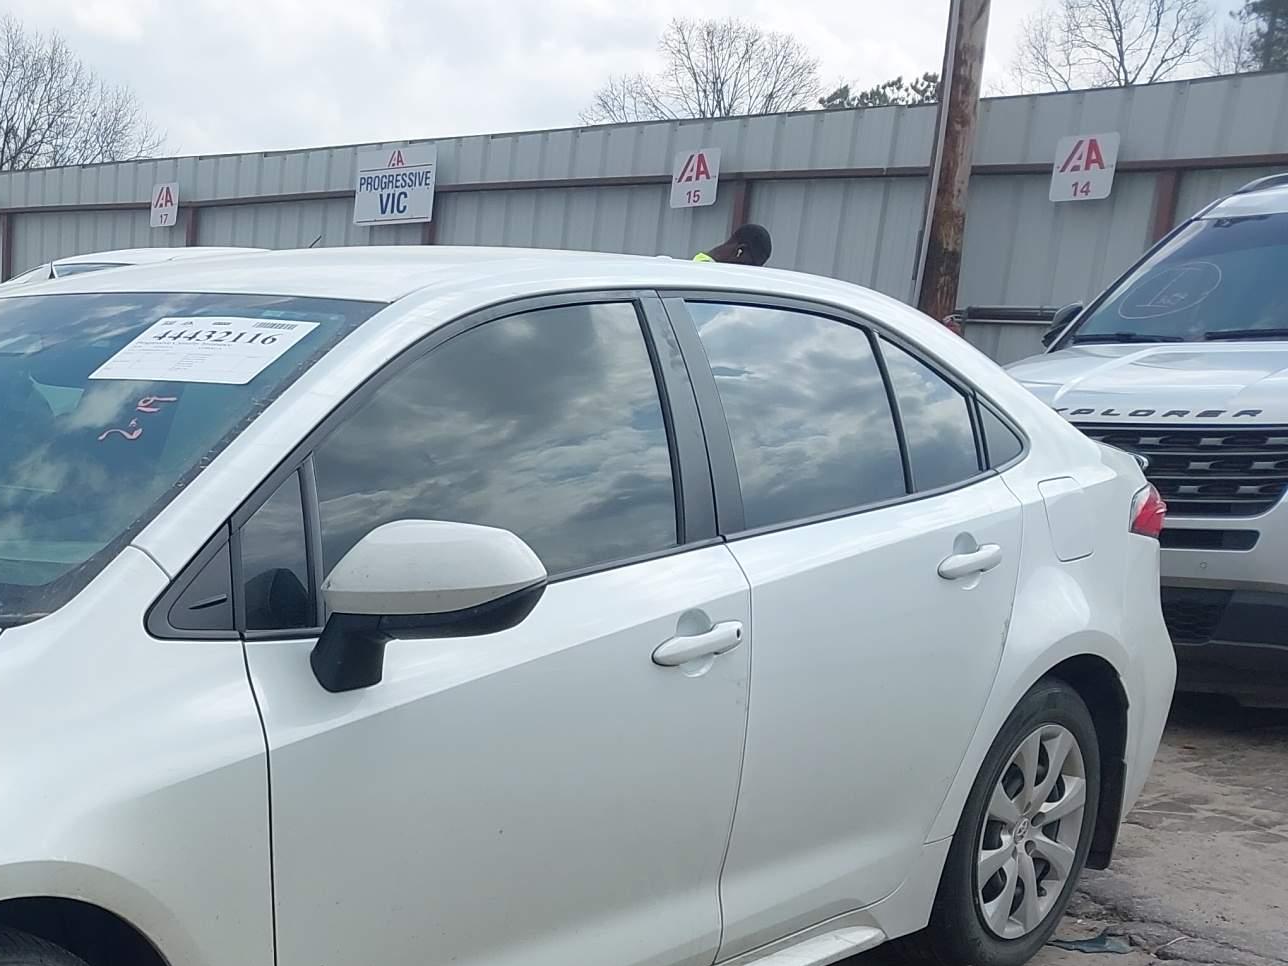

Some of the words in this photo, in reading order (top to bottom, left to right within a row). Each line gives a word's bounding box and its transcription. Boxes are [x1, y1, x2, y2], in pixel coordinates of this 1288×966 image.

[359, 170, 432, 192] PROGRESSIVE
[1072, 181, 1091, 197] 14
[379, 191, 408, 215] VIC
[686, 189, 701, 204] 15
[160, 213, 169, 225] 17
[153, 329, 282, 346] 44432116
